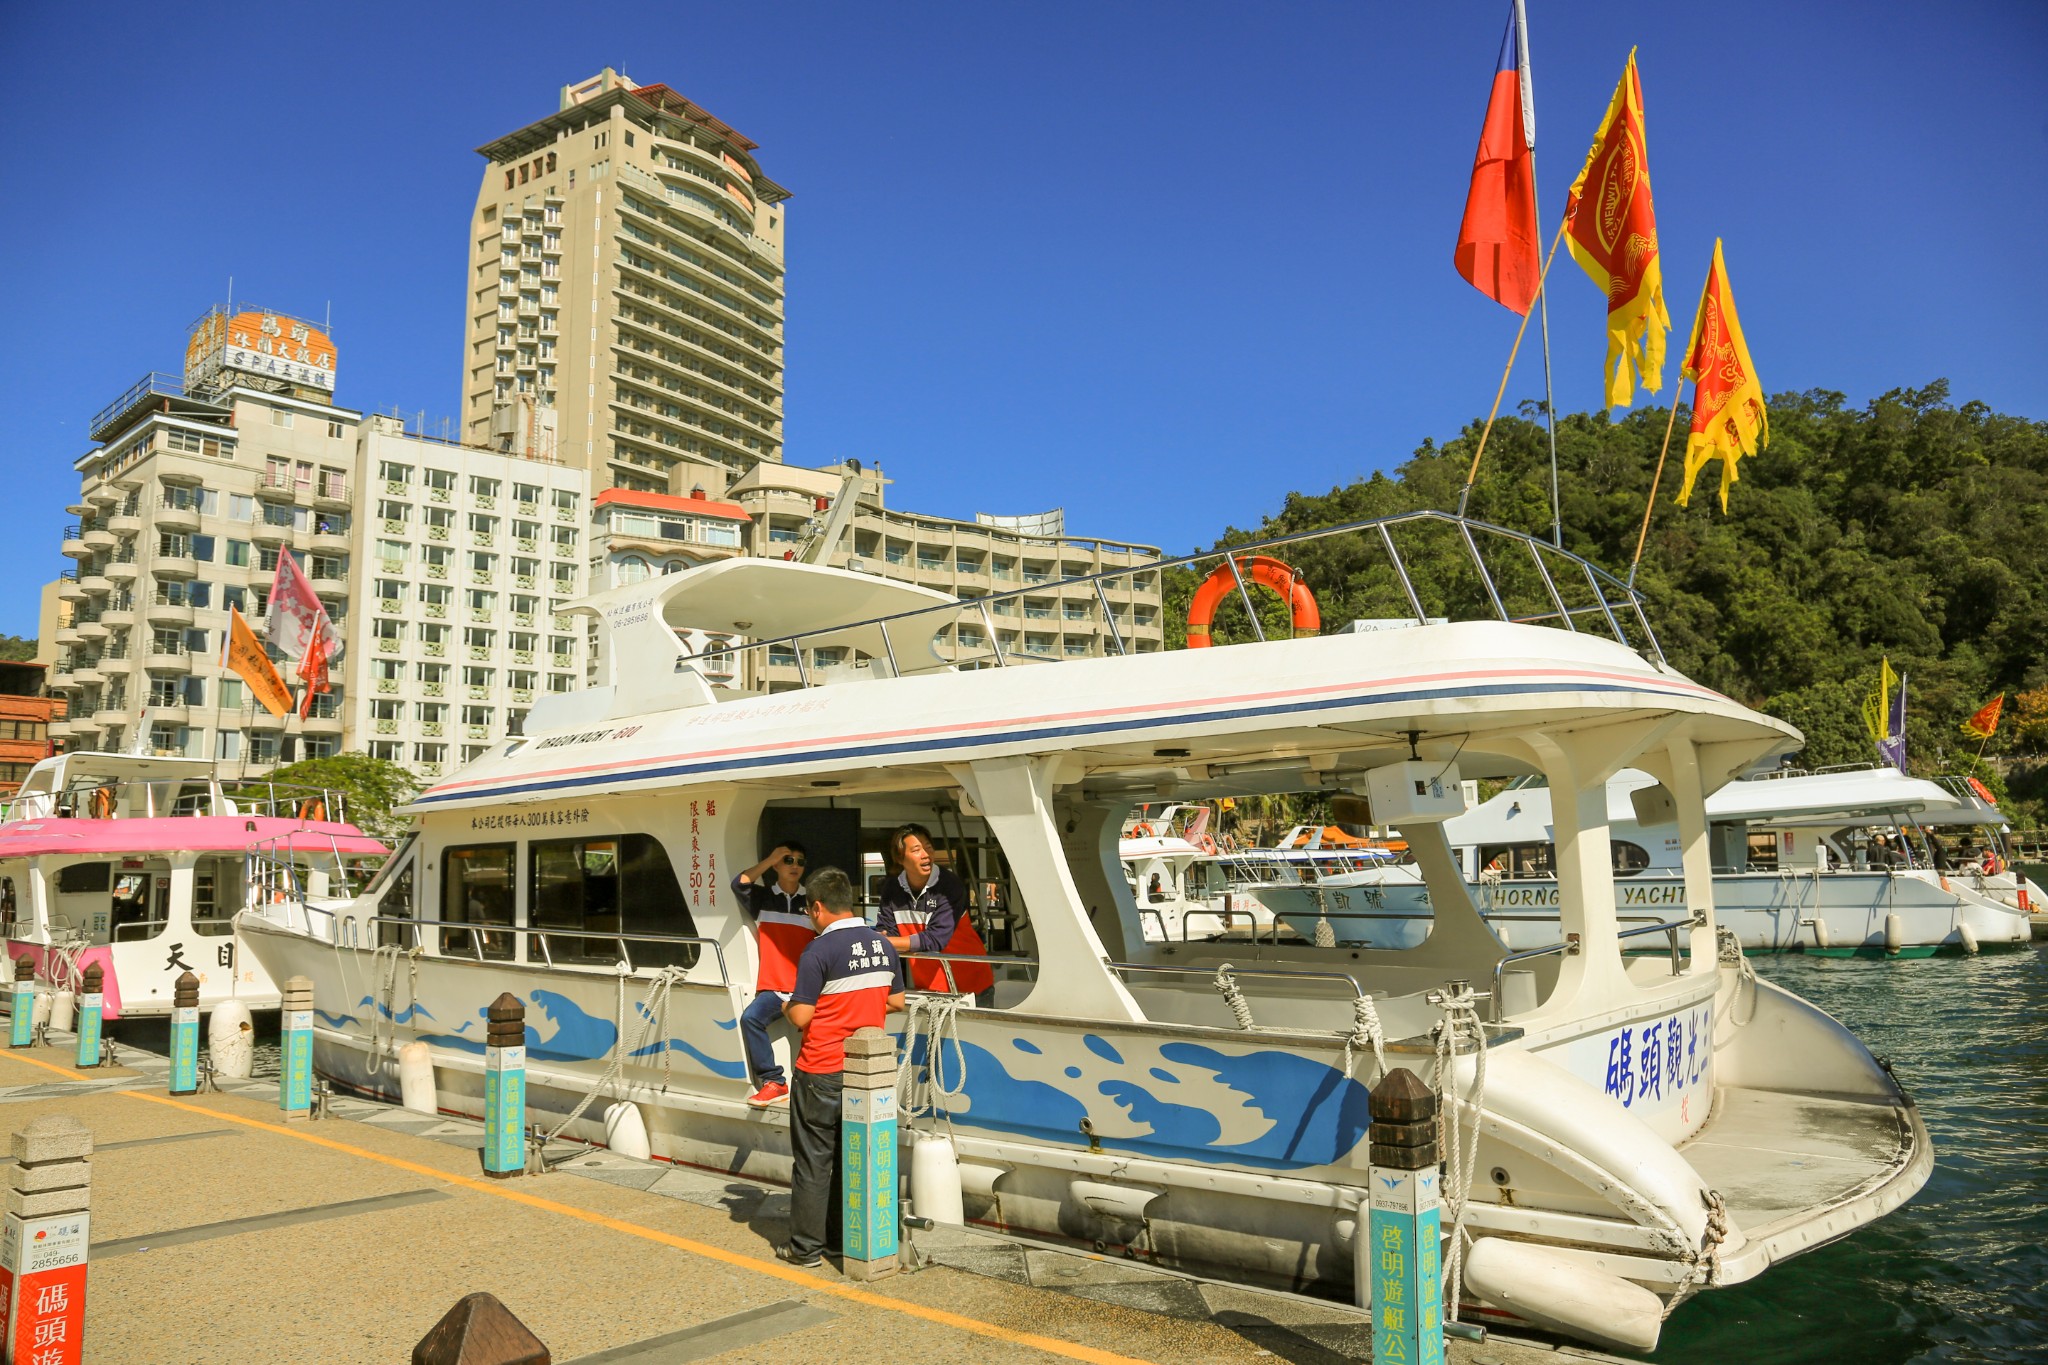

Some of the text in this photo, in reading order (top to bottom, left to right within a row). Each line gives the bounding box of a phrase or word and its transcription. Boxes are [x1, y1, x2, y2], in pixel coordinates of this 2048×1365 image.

[1604, 183, 1617, 229] WENWU
[260, 316, 310, 346] 碼頭
[535, 735, 578, 749] DRAGON
[574, 729, 614, 744] YACHT
[689, 801, 702, 907] 限載乘客50員
[1495, 886, 1686, 906] HORNG YACHT
[851, 940, 885, 957] 碼頭
[31, 1253, 79, 1270] 2855656
[1381, 1224, 1406, 1365] 啓明遊艇公
[1423, 1223, 1440, 1365] 啓明遊艇公
